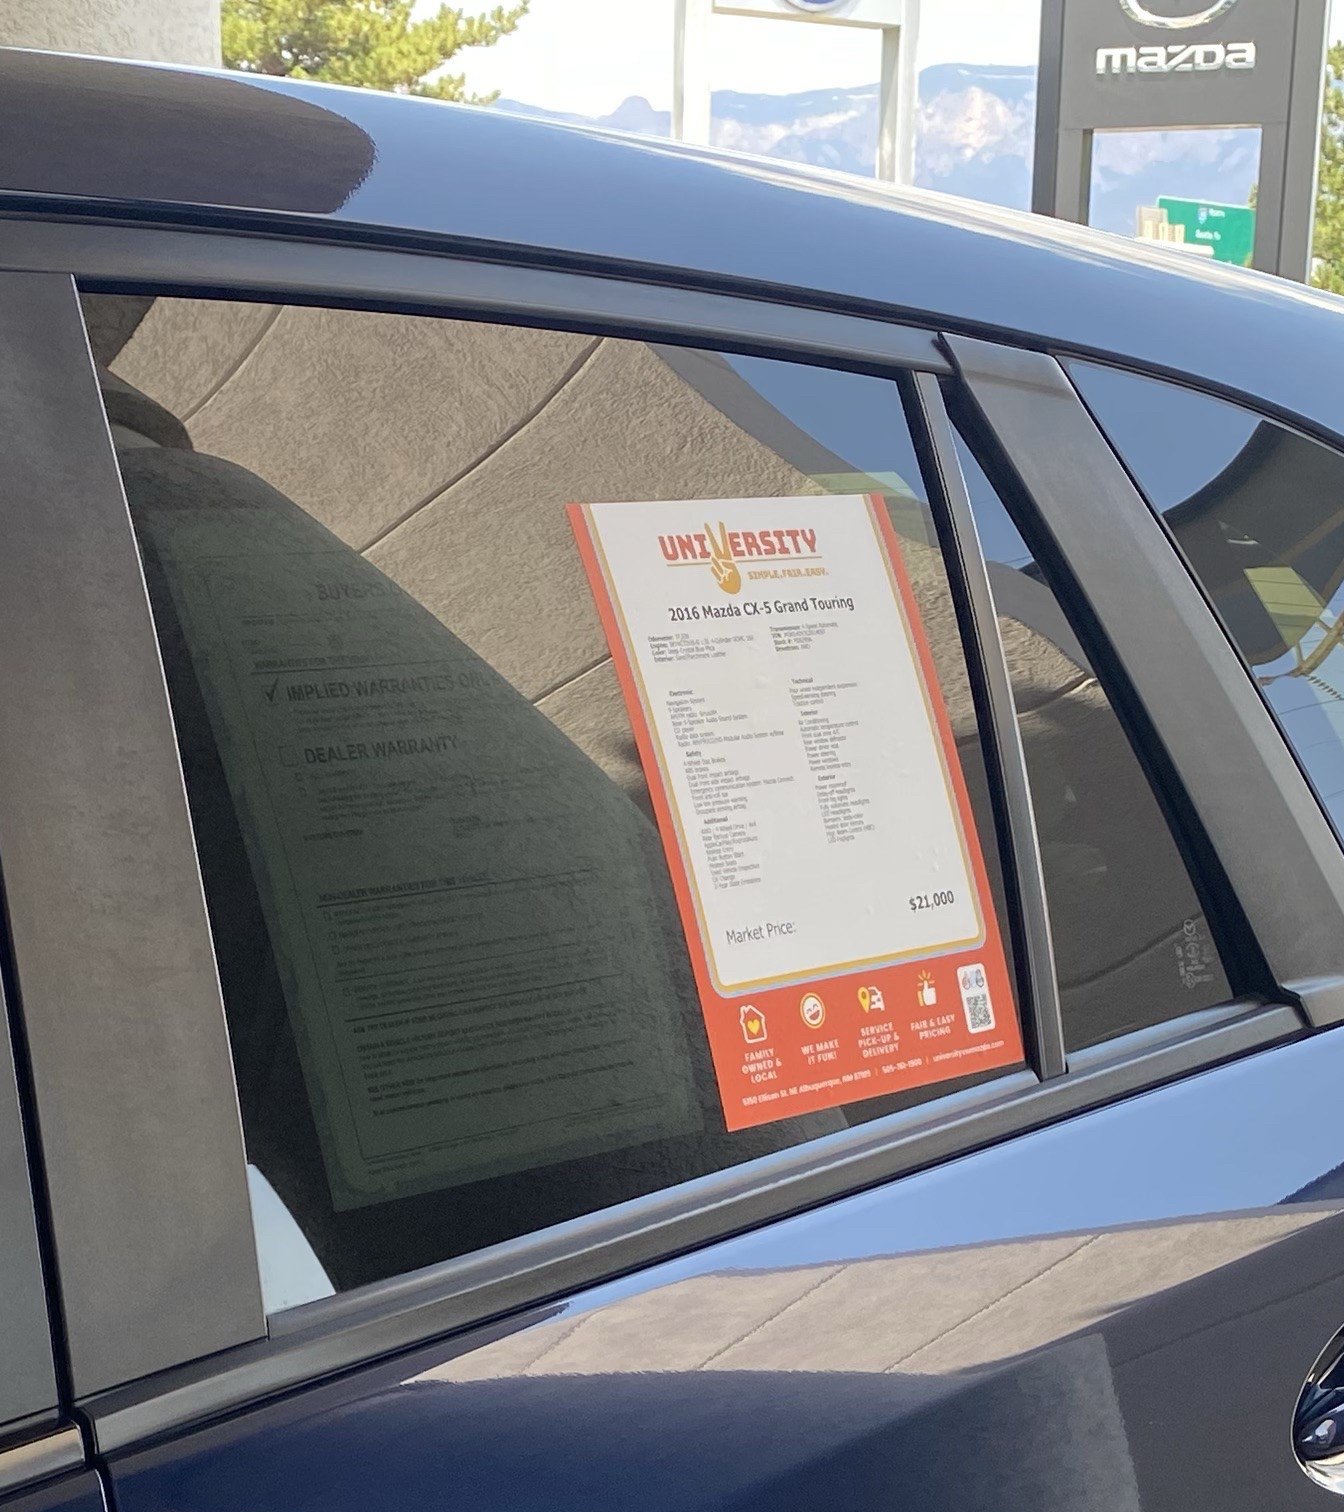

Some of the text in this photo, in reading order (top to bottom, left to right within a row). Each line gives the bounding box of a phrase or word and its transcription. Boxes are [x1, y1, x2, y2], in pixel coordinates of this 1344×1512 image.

[1096, 42, 1256, 75] mazda
[657, 528, 820, 560] UNIVERSITY
[668, 596, 855, 622] 2016 Mazda CX-5 Grand Touring
[286, 681, 350, 702] IMPLIED
[350, 674, 456, 698] WARRANTIES
[303, 734, 458, 765] DEALER WARRANTY
[908, 888, 956, 913] $21,000
[725, 917, 797, 946] Market Price:
[860, 1021, 894, 1036] SERVICE
[910, 1019, 928, 1031] FAIR
[937, 1013, 956, 1025] EASY
[919, 1025, 952, 1040] PRICING
[800, 1038, 840, 1055] WE MAKE
[858, 1034, 892, 1049] PICK-UP
[862, 1042, 899, 1058] DELIVERY
[744, 1047, 775, 1062] FAMILY
[817, 1050, 838, 1063] FUN!
[742, 1059, 774, 1075] OWNED
[751, 1070, 778, 1084] LOCAL
